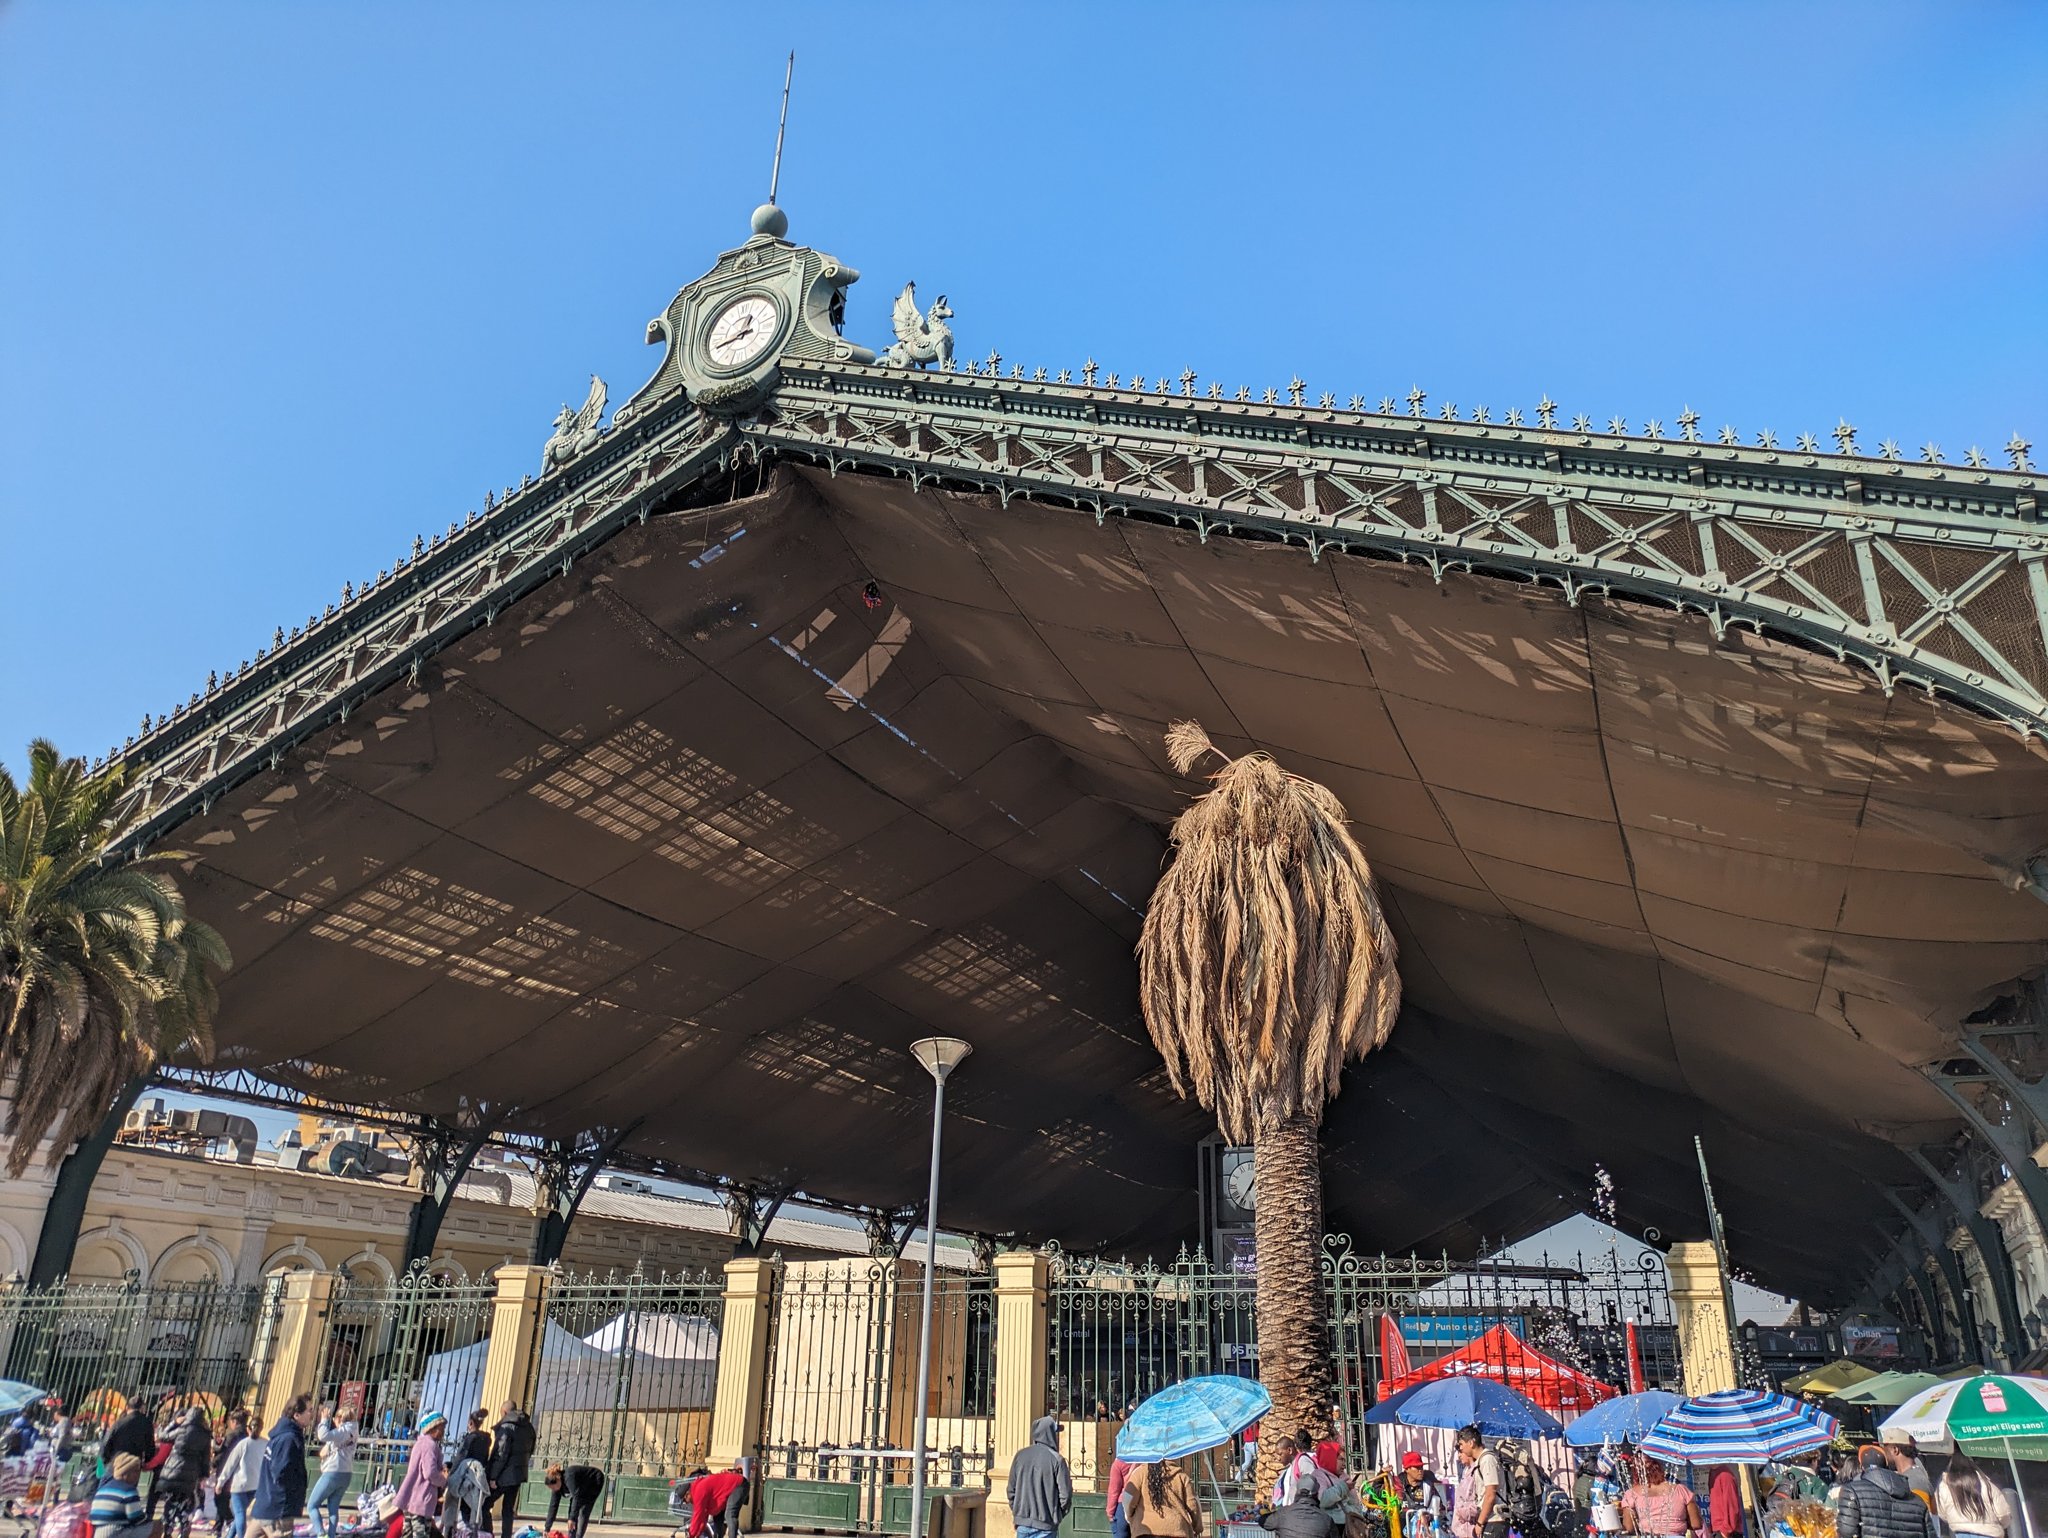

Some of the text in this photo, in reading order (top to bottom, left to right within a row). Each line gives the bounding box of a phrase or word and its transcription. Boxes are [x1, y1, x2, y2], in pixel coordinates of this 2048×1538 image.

[1435, 1323, 1460, 1331] Punto
[1462, 1323, 1473, 1331] de
[1063, 1329, 1091, 1338] Central
[1961, 1421, 2044, 1434] Elige oye! Elige sano!
